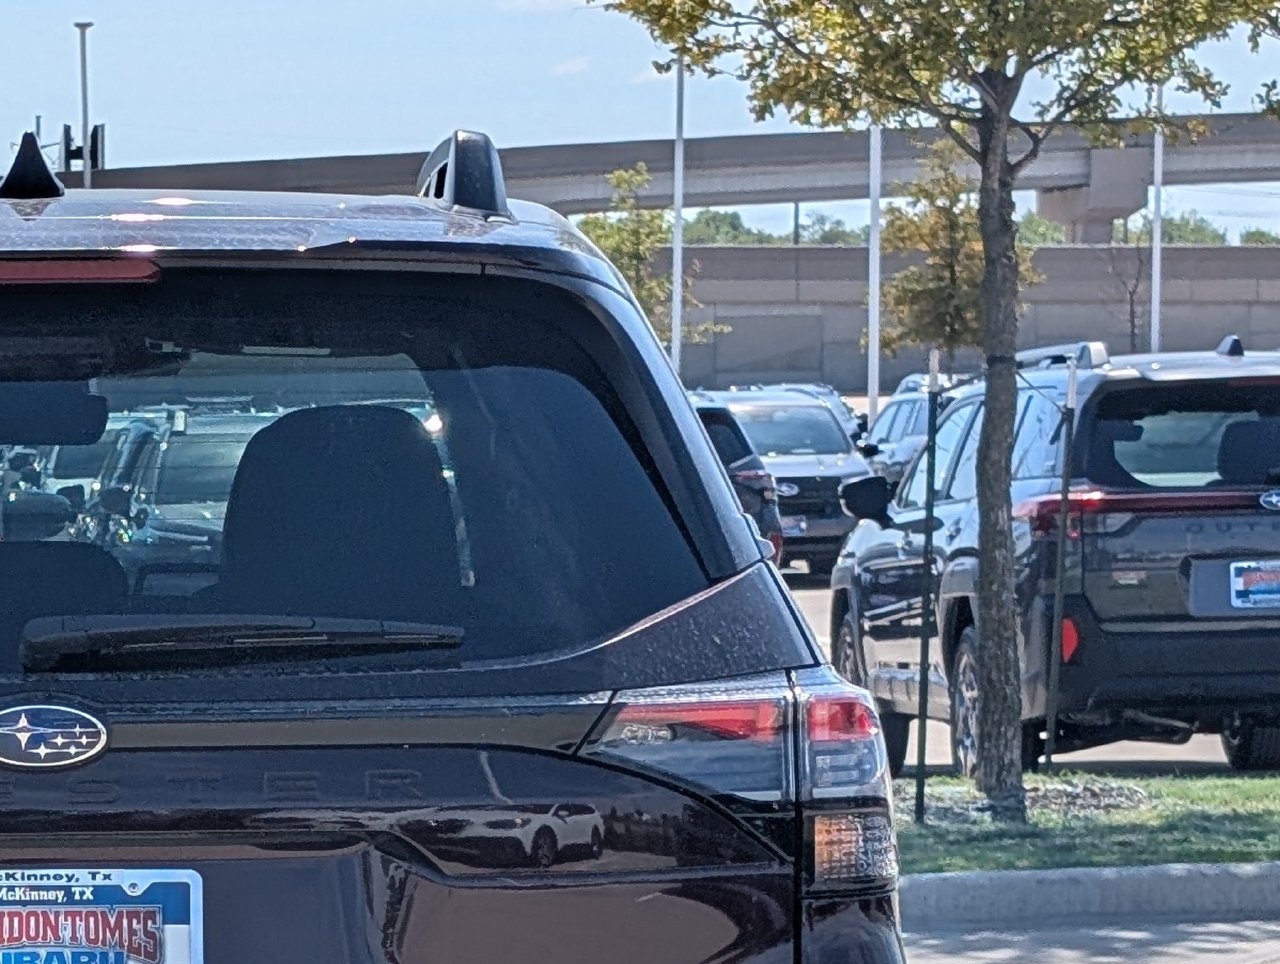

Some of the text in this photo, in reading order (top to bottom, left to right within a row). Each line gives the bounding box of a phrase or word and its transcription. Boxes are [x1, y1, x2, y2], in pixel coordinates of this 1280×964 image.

[87, 870, 113, 881] Tx
[71, 886, 95, 900] TX
[63, 908, 159, 963] TOMES
